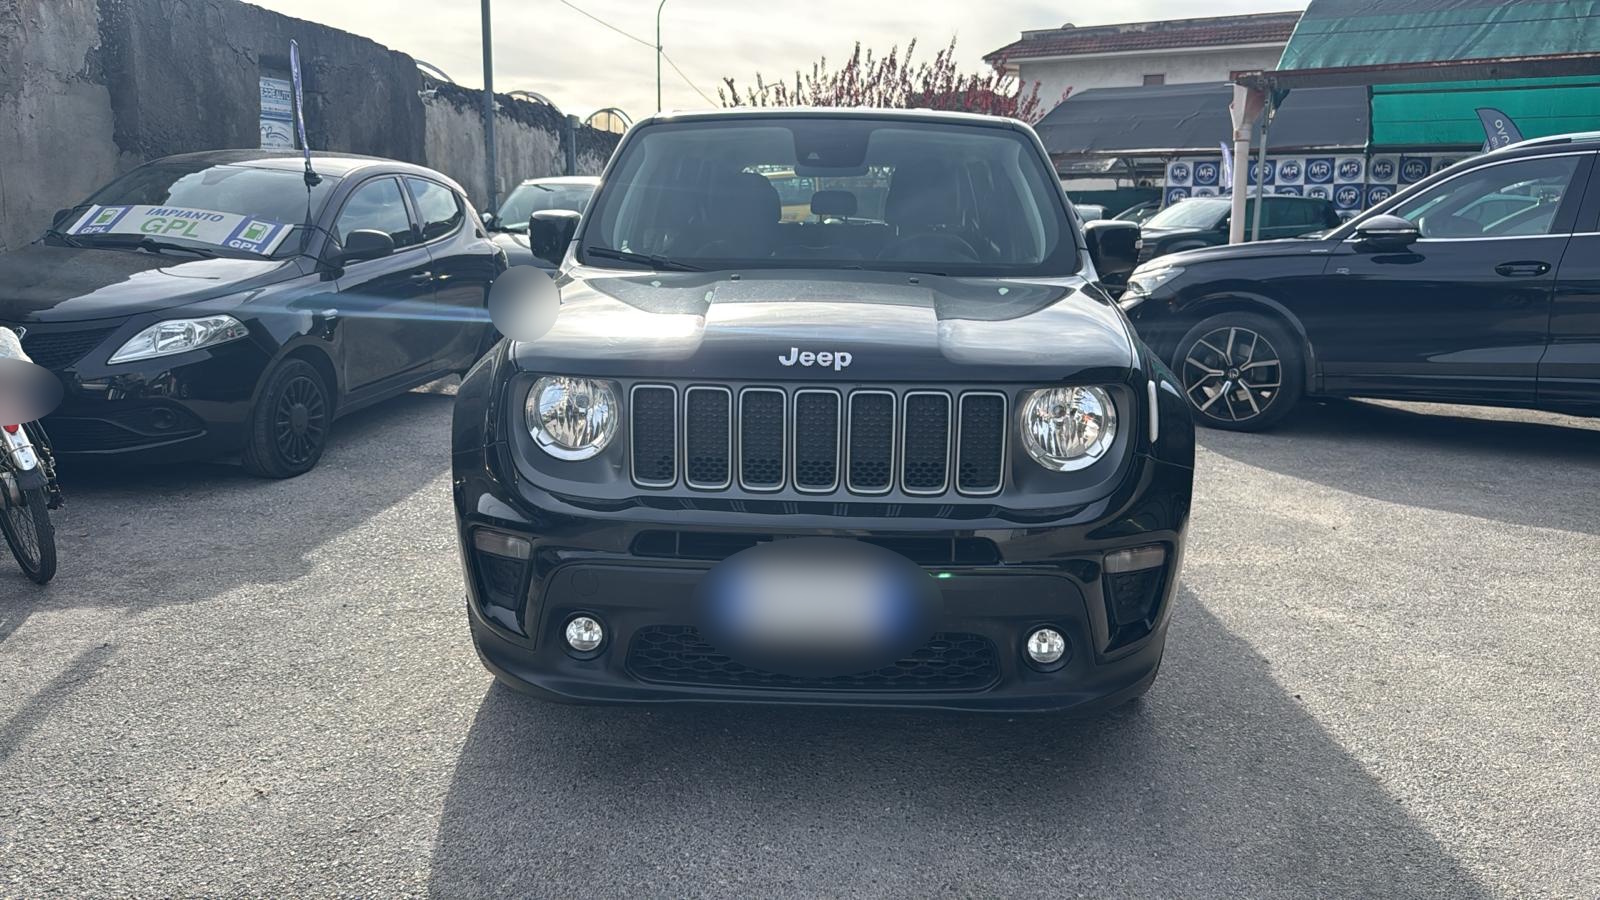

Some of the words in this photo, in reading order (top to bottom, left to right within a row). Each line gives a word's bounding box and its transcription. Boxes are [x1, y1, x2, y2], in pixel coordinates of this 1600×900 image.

[1173, 168, 1187, 178] MR
[1199, 167, 1213, 177] MR
[1282, 166, 1298, 176] MR
[1311, 165, 1328, 175] MR
[1341, 164, 1358, 175] MR
[1374, 164, 1392, 174] MR
[1405, 163, 1423, 175] MR
[1339, 191, 1356, 201] MR
[145, 208, 225, 222] IMPIANTO
[80, 226, 107, 234] GPL
[140, 217, 200, 238] GPL
[228, 239, 260, 252] GPL
[778, 347, 853, 371] Jeep
